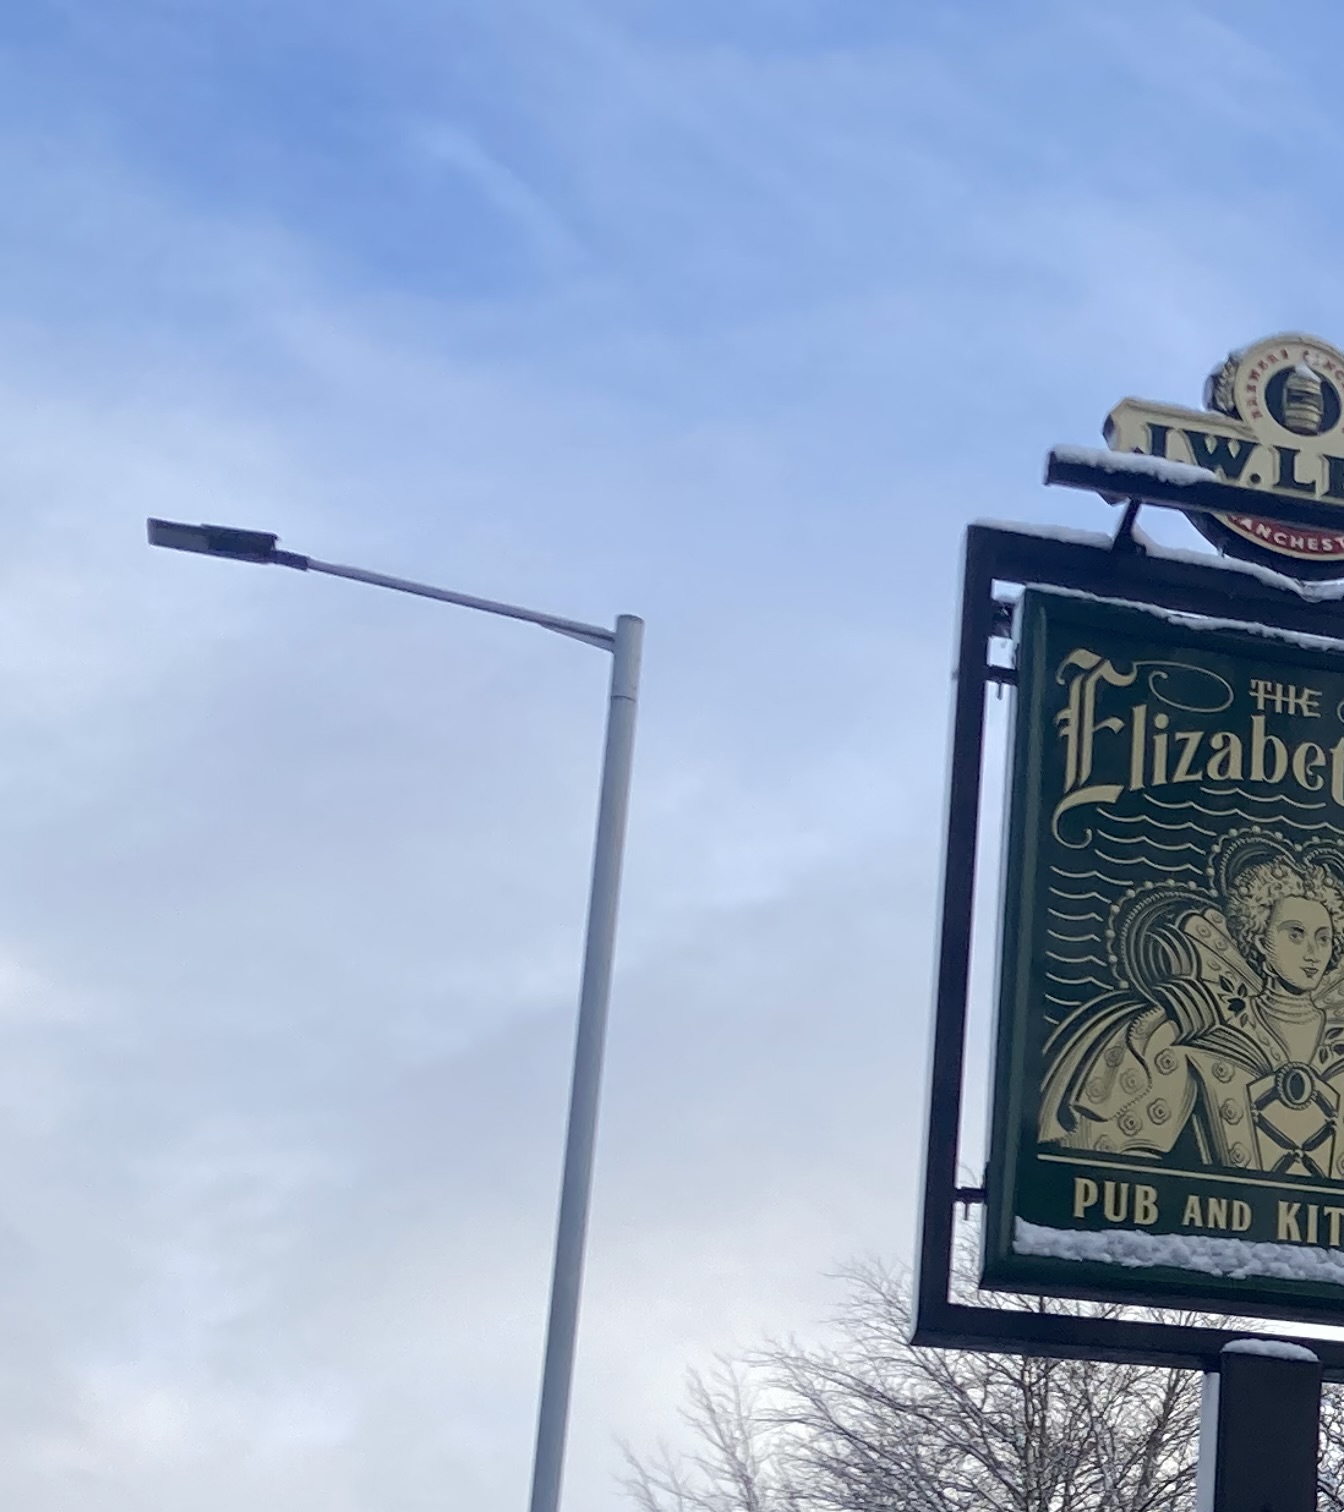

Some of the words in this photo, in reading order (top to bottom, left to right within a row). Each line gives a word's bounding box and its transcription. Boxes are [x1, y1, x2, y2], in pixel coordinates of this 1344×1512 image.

[1248, 678, 1323, 718] THE
[1072, 1176, 1160, 1226] PUB
[1181, 1194, 1254, 1233] AND
